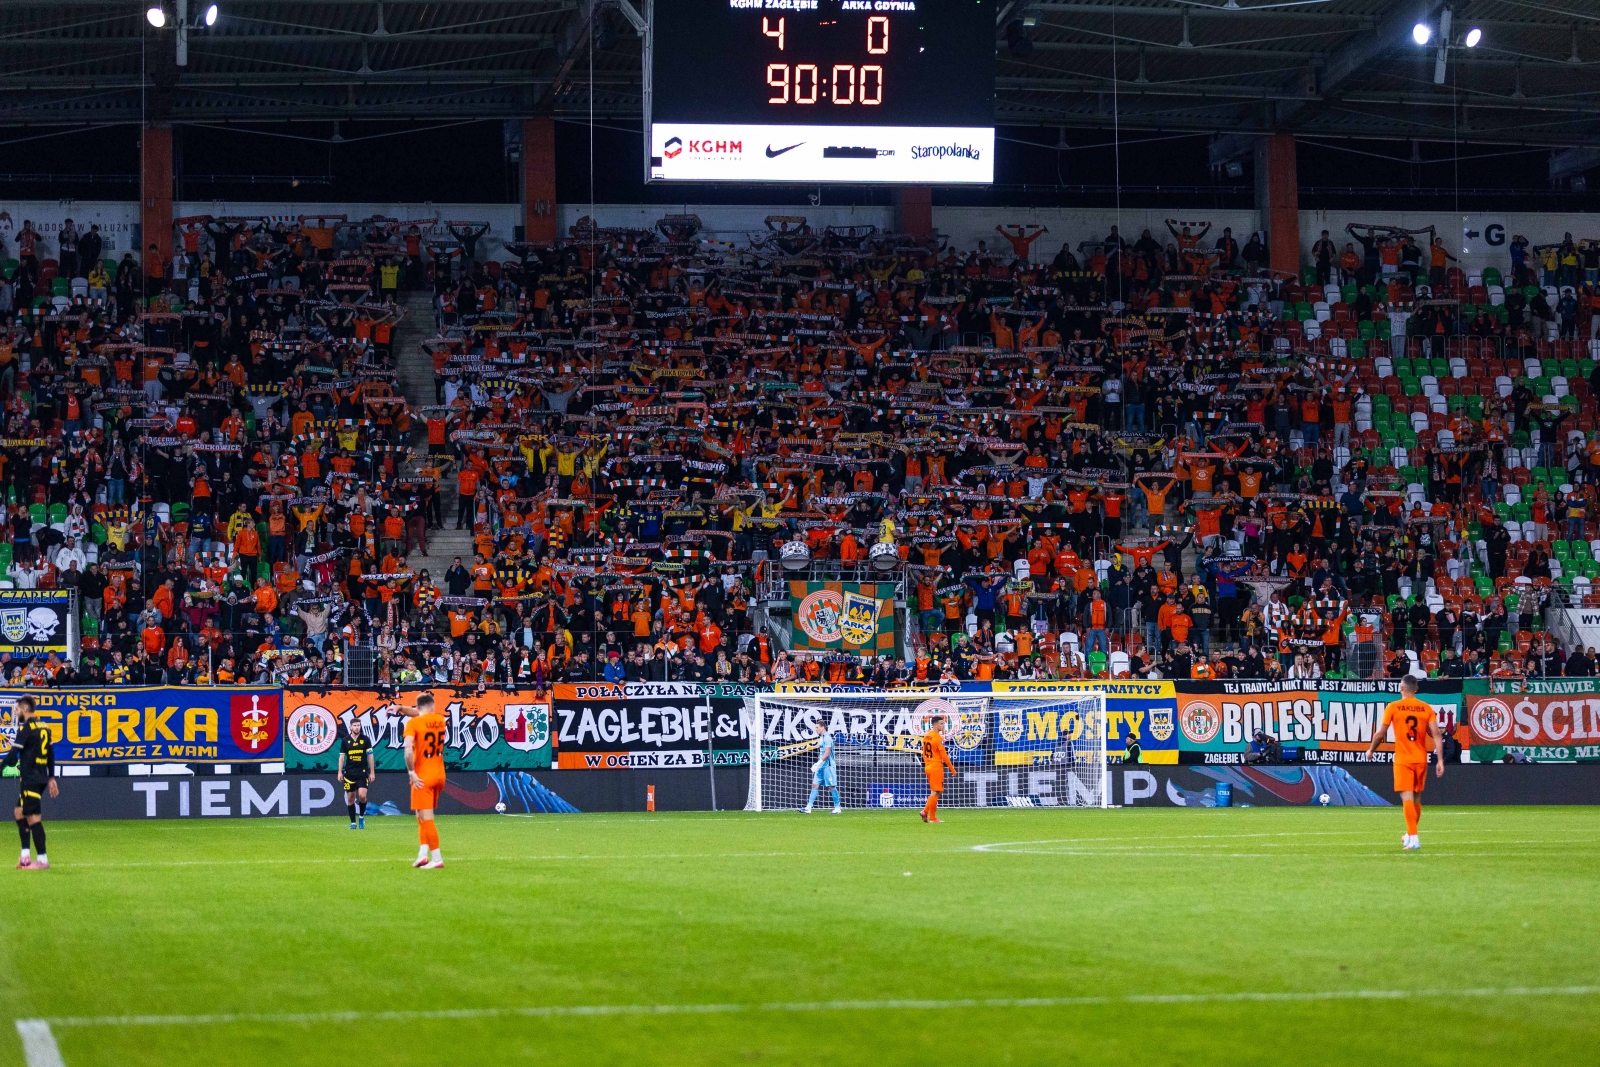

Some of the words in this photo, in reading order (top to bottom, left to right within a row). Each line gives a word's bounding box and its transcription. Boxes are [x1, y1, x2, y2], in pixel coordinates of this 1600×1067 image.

[842, 1, 872, 10] ARKA
[874, 1, 915, 11] GDYNIA
[762, 16, 785, 50] 4
[867, 16, 889, 54] 0
[766, 63, 883, 105] 90:00
[689, 140, 742, 154] KGHM
[911, 143, 980, 160] Staropolanka
[1485, 224, 1505, 246] G
[0, 590, 59, 603] CZAREK
[842, 619, 873, 631] ARKA
[13, 646, 45, 658] PDW
[576, 685, 679, 699] POŁĄCZYŁA
[682, 685, 716, 696] NAS
[1224, 683, 1239, 693] TEJ
[1240, 681, 1280, 693] TRADYCJI
[1282, 679, 1302, 691] NIKT
[1303, 680, 1317, 690] NIE
[1319, 680, 1340, 690] JEST
[1377, 681, 1387, 691] W
[1396, 705, 1426, 713] YAKUBA
[557, 706, 715, 748] ZAGŁĘBIE
[827, 705, 913, 737] ARKA
[1026, 710, 1145, 741] MOSTY
[1405, 715, 1418, 741] 3
[40, 729, 48, 755] 2
[72, 746, 146, 759] ZAWSZE
[152, 745, 163, 756] Z
[168, 745, 218, 758] WAMI
[1204, 753, 1239, 765] ZAGŁĘBIE
[1303, 751, 1319, 761] YŁO,
[1320, 751, 1338, 761] JEST
[1344, 751, 1354, 761] NA
[586, 756, 602, 767] W
[607, 752, 656, 767] OGIEŃ
[664, 754, 687, 765] ZA
